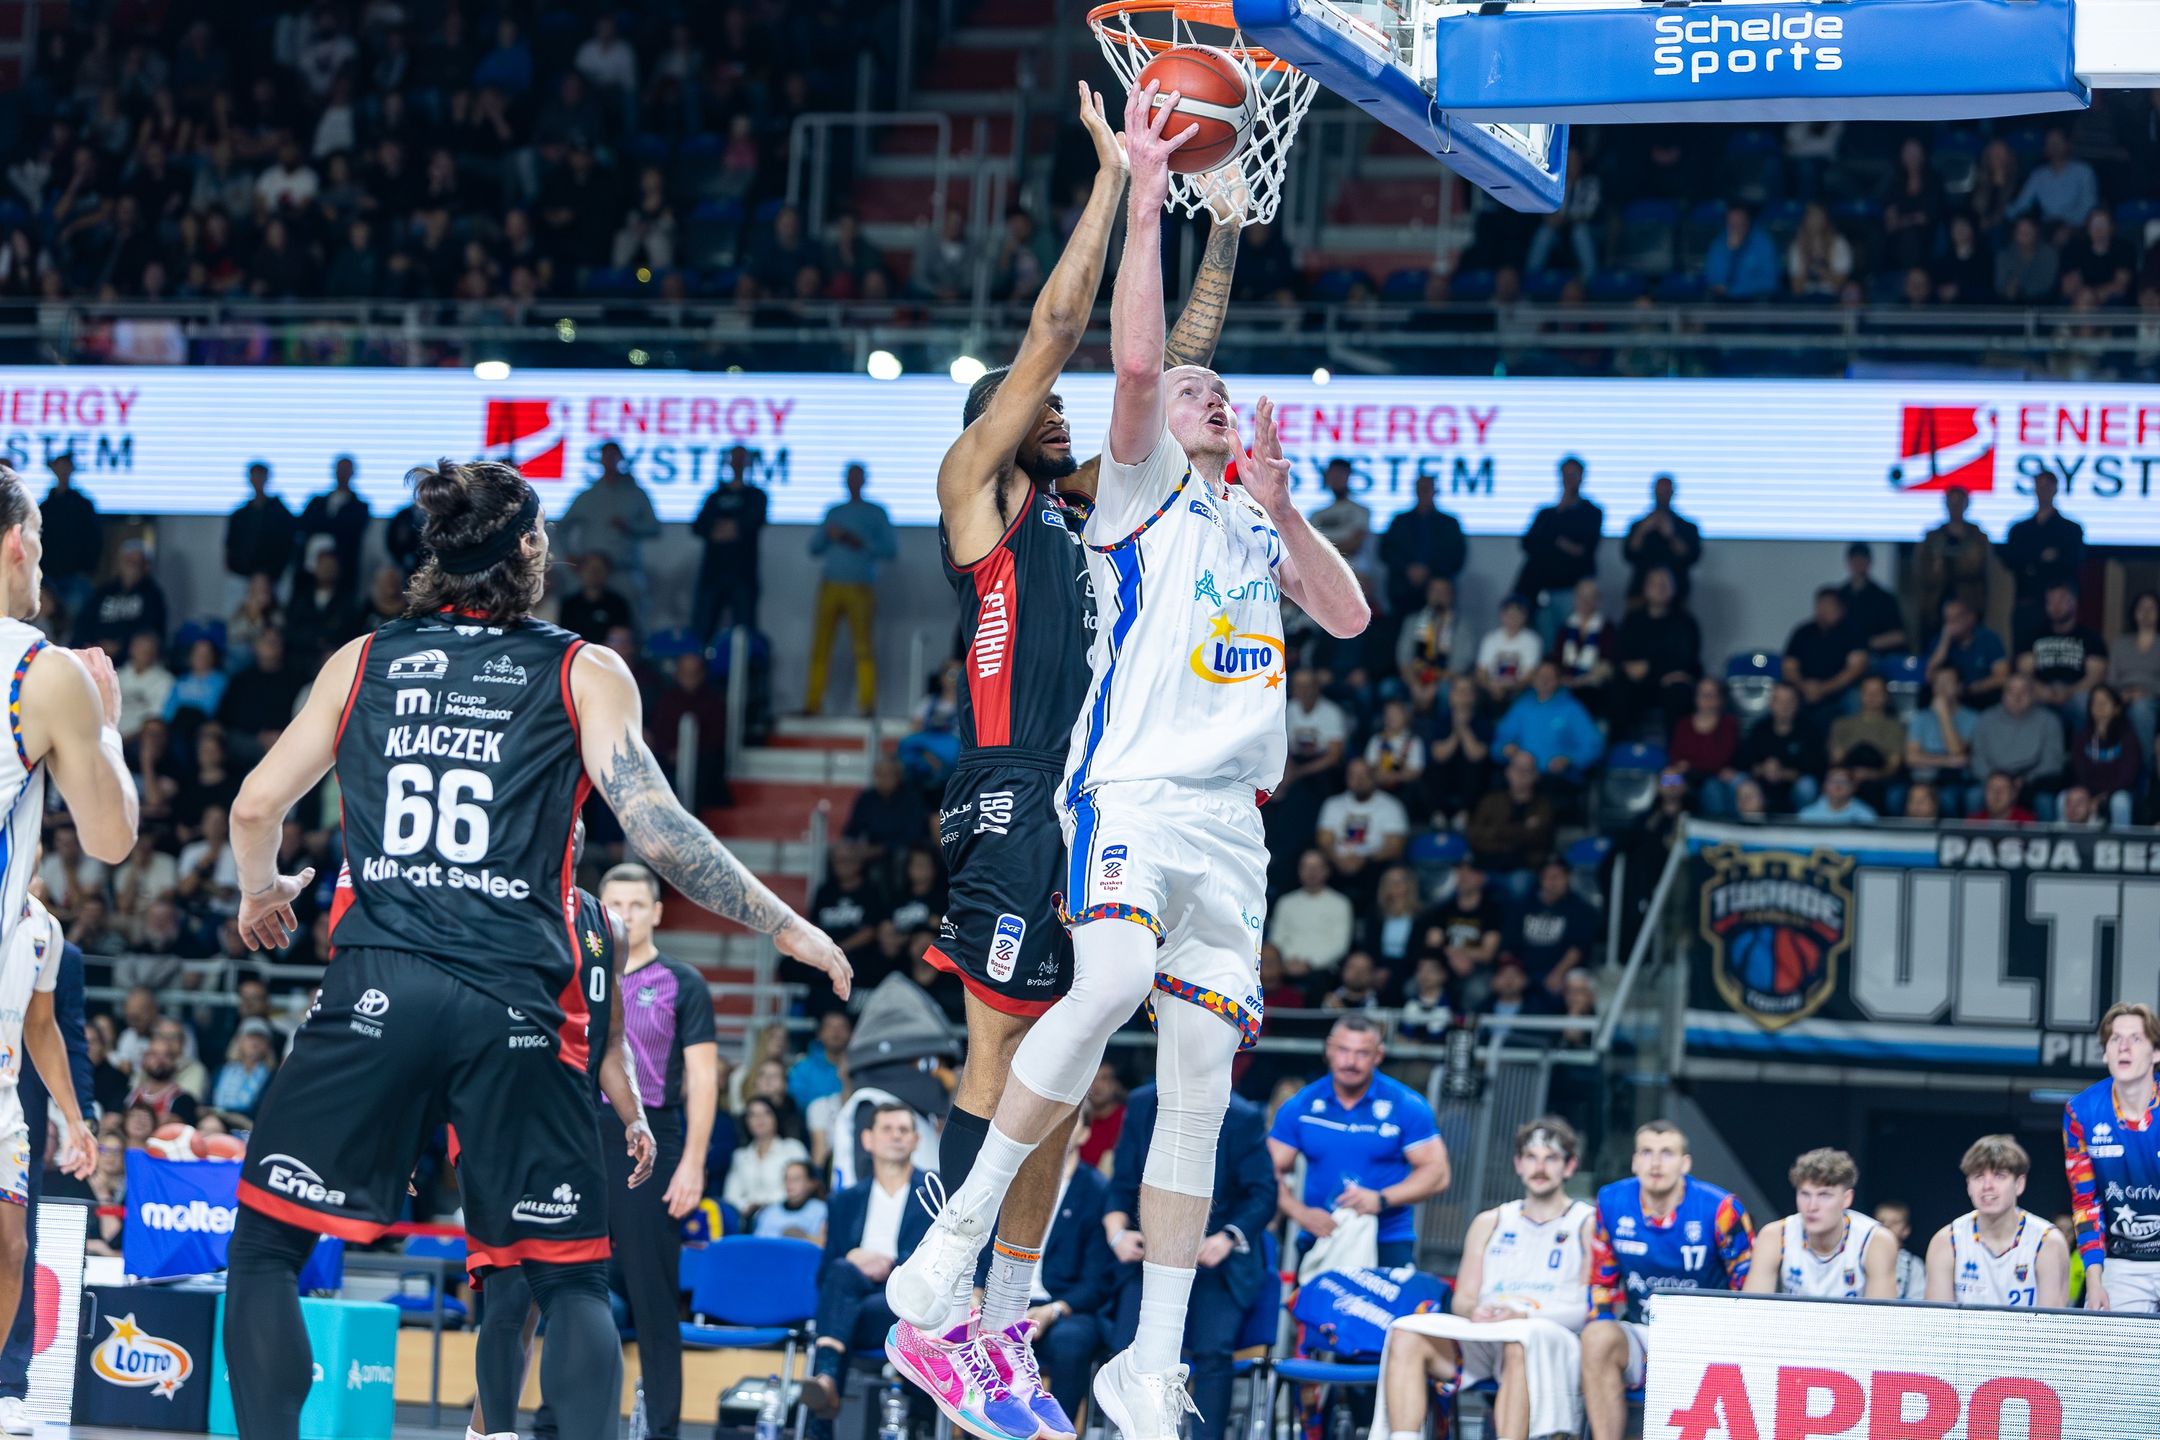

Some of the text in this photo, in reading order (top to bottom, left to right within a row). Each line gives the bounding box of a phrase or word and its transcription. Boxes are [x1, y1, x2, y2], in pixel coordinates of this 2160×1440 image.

[1654, 12, 1843, 45] Schelde
[1653, 41, 1843, 83] Sports
[585, 397, 796, 436] ENERGY
[1277, 404, 1498, 446] ENERGY
[584, 443, 792, 485] SSTM
[388, 662, 449, 674] PTS
[1214, 642, 1272, 673] LOTTO
[444, 703, 514, 721] Moderator
[446, 691, 487, 705] Grupa
[384, 725, 504, 763] KŁACZEK
[382, 763, 494, 864] 66
[973, 790, 1015, 836] 1924
[1939, 836, 2081, 870] PASJA
[1000, 922, 1022, 934] PGE
[267, 1165, 347, 1206] Enea
[519, 1200, 579, 1216] MLEKPOL
[1680, 1244, 1707, 1271] 17
[2008, 1287, 2036, 1307] 27
[115, 1344, 172, 1374] LOTTO
